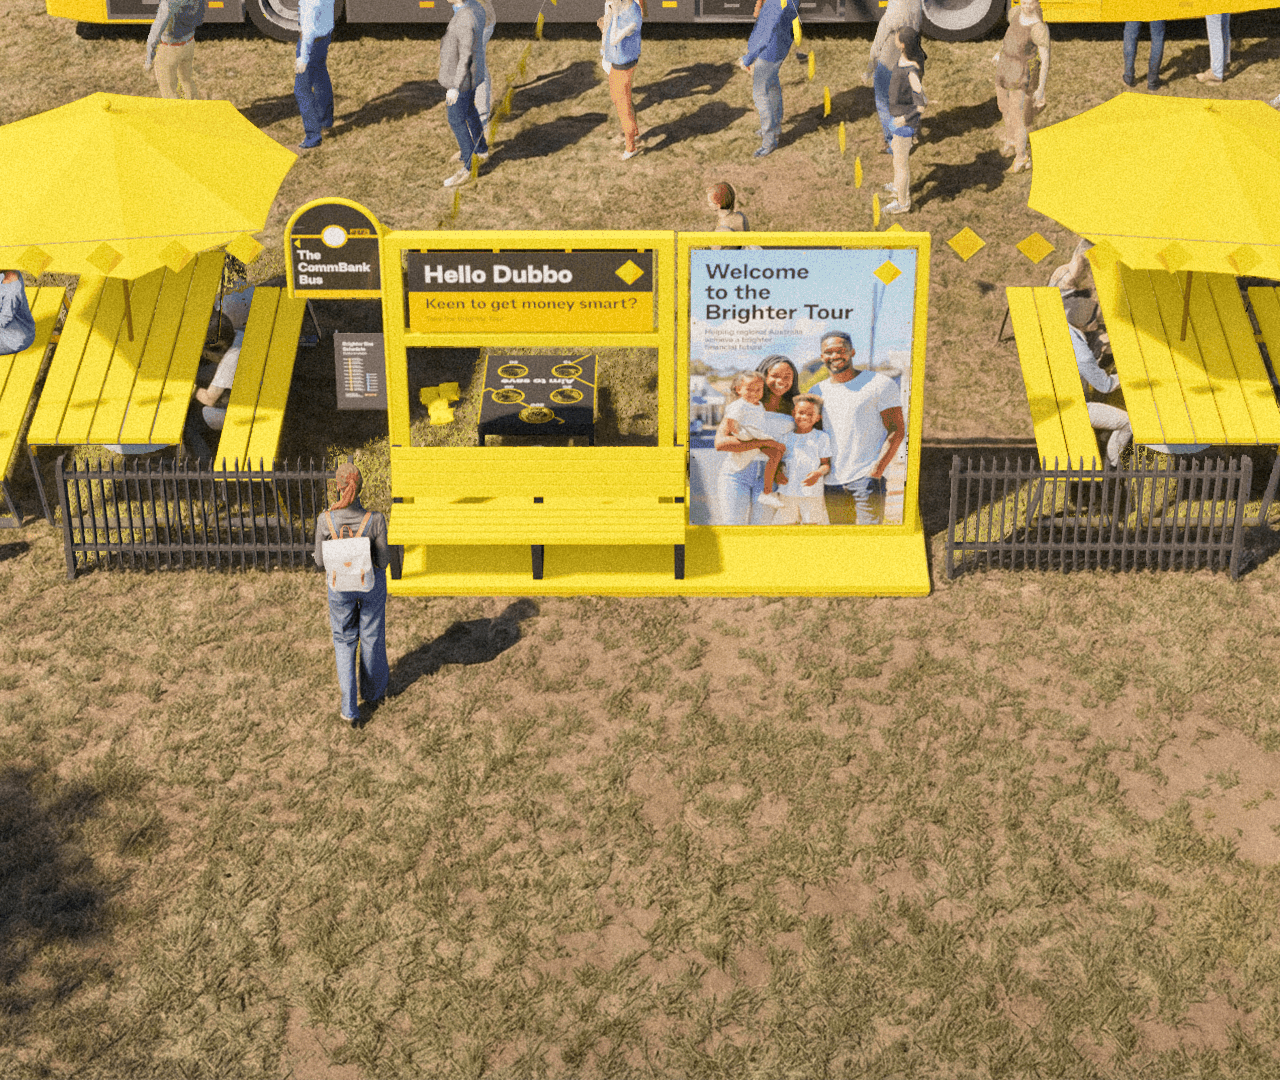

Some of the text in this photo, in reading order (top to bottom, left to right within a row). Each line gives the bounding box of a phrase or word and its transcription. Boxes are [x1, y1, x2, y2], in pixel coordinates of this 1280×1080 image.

[296, 249, 321, 261] The
[297, 262, 371, 273] CommBank
[424, 264, 573, 284] Hello Dubbo
[705, 263, 809, 280] Welcome
[298, 274, 323, 285] Bus
[705, 284, 771, 300] to the
[425, 297, 638, 312] Keen to get money smart?
[706, 304, 854, 324] Brighter Tour
